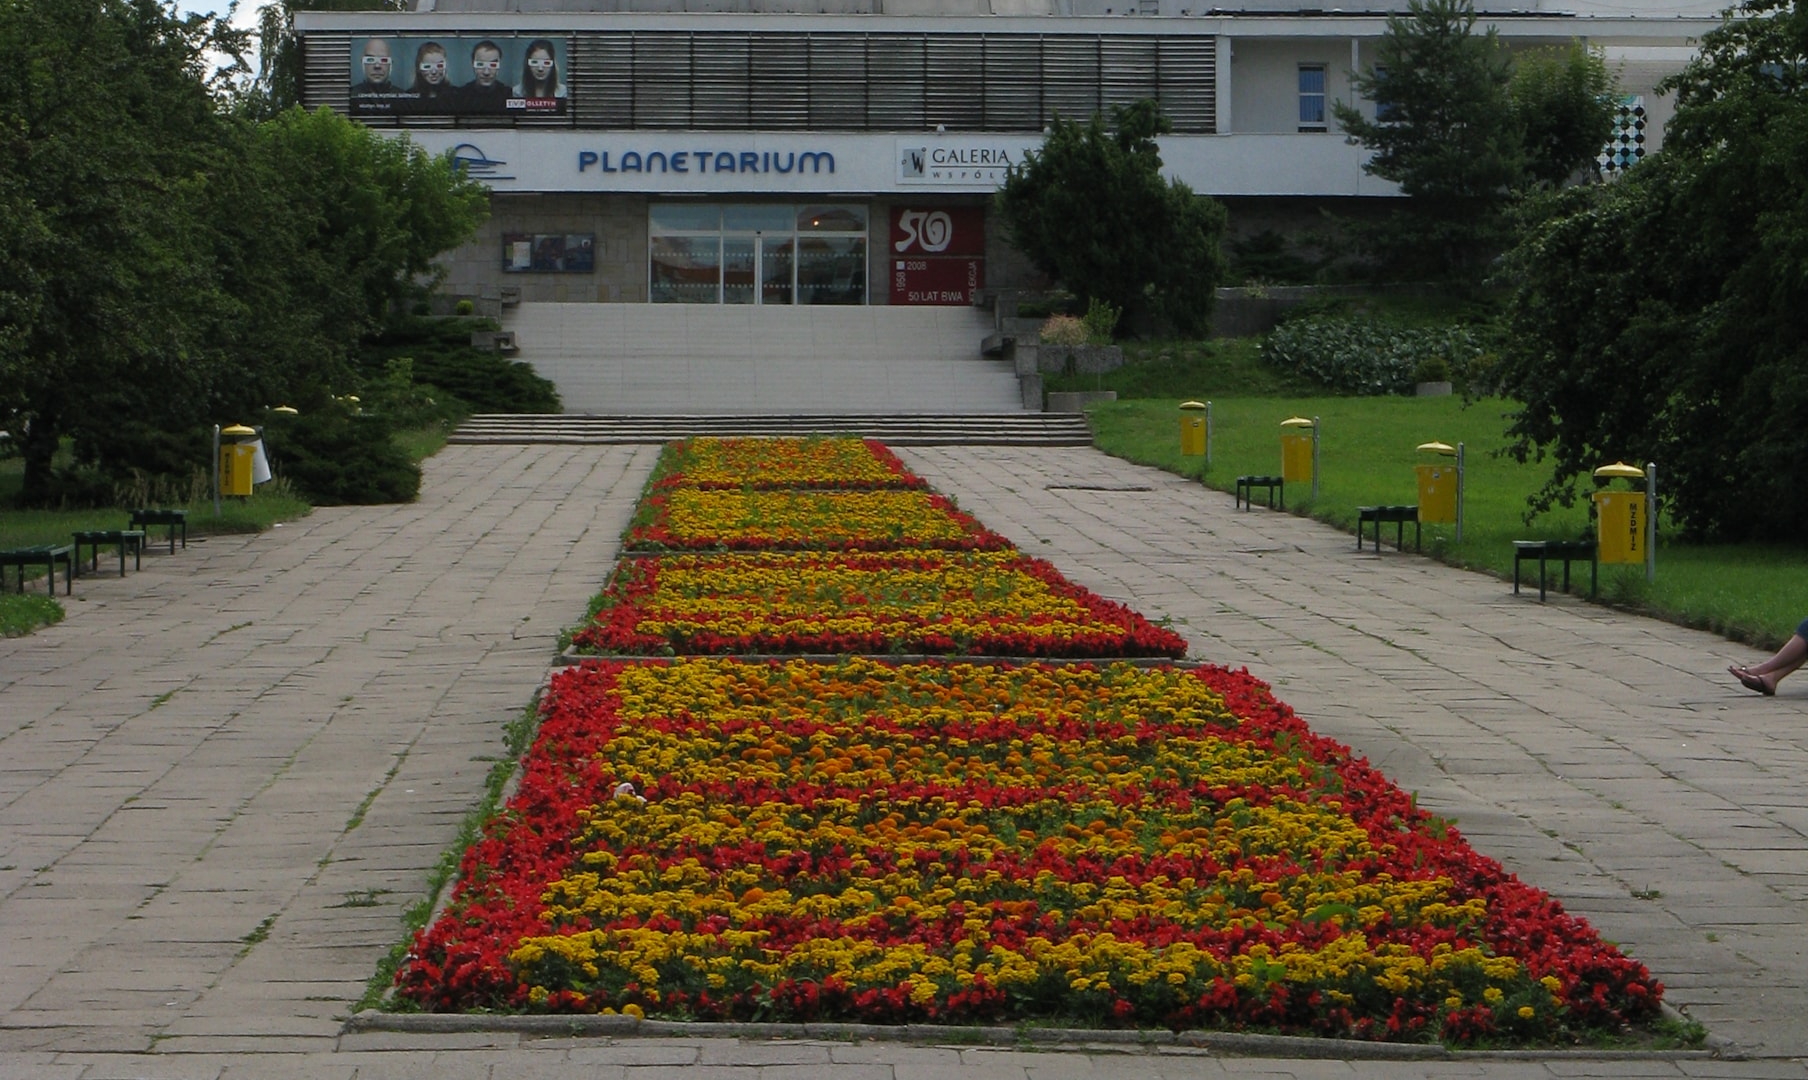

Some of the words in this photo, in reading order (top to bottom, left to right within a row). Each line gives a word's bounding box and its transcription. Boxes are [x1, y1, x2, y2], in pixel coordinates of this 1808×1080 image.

[579, 151, 835, 173] PLANETARIUM
[932, 149, 1009, 163] GALERIA
[895, 209, 952, 252] 50
[907, 261, 927, 270] 2008
[896, 272, 906, 291] 1958
[908, 291, 919, 301] 50
[921, 291, 938, 301] LAT
[941, 291, 963, 301] BWA
[1629, 503, 1637, 551] MZDMIZ
